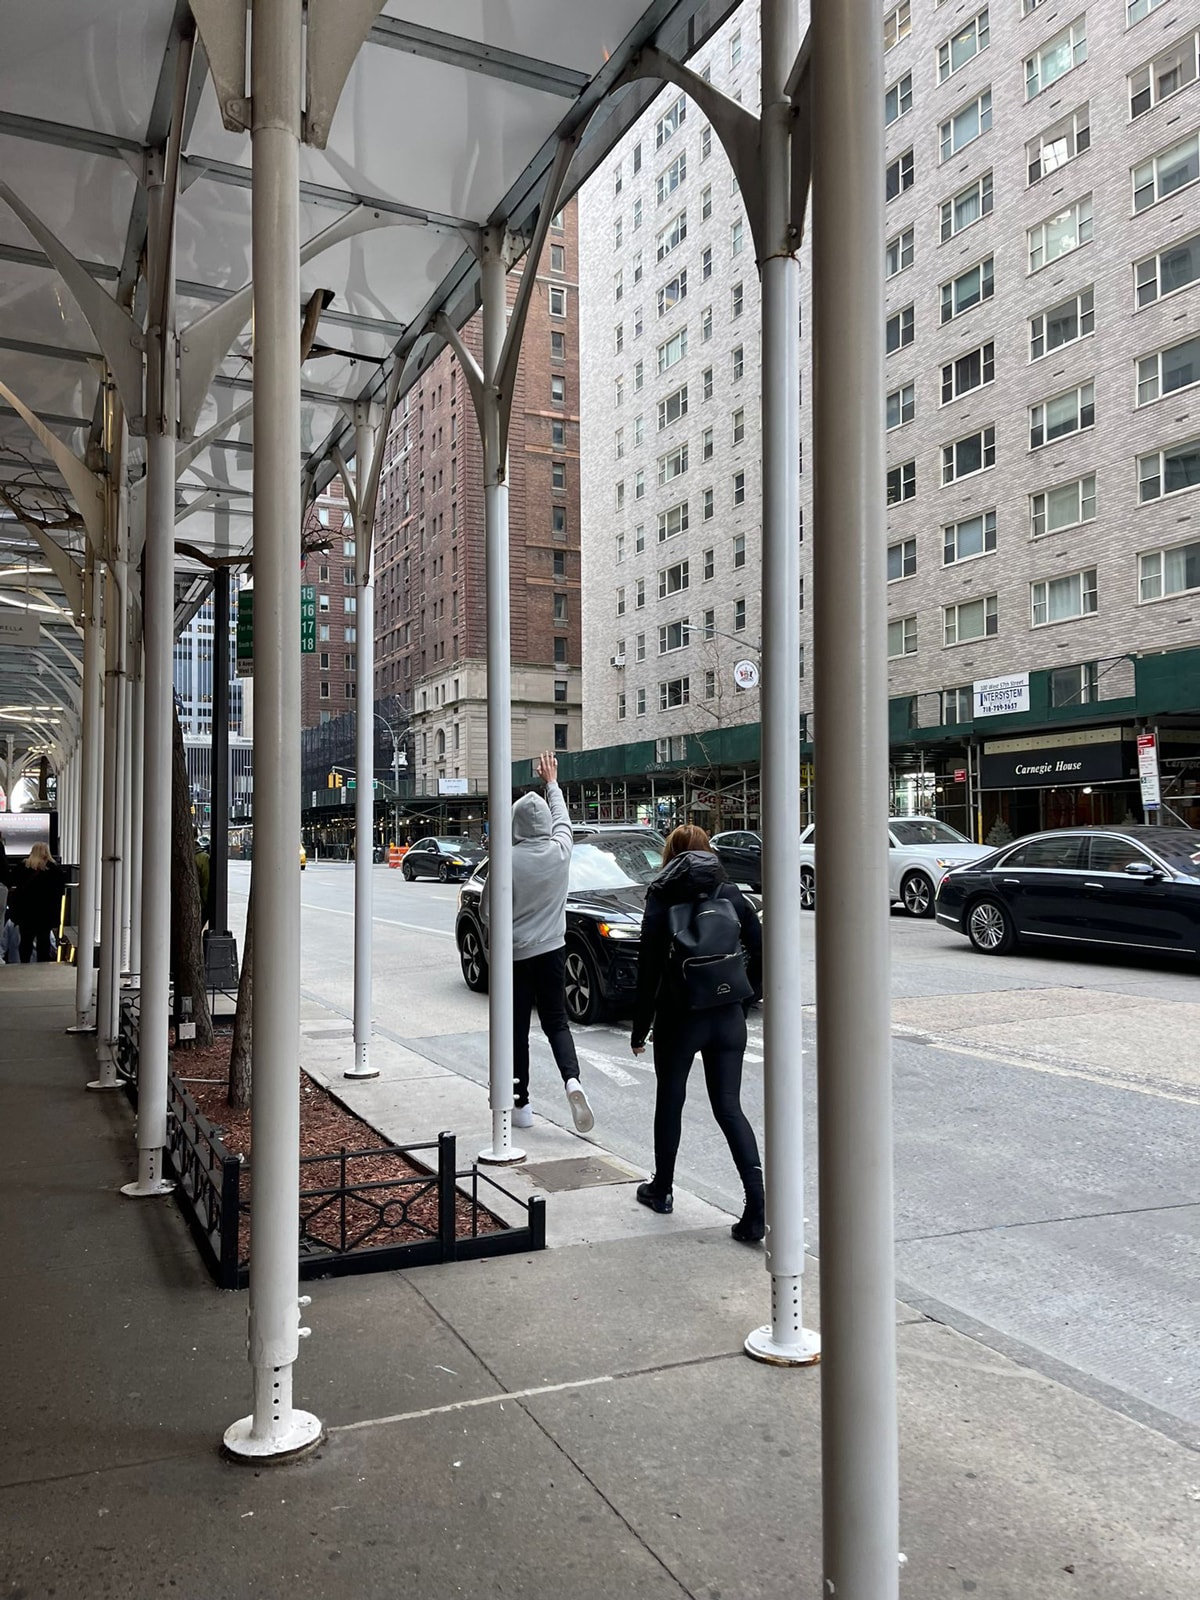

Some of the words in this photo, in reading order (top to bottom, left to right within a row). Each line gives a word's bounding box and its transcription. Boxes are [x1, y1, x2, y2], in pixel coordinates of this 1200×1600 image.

[301, 587, 313, 600] 15
[301, 604, 314, 616] 16
[301, 621, 314, 634] 17
[301, 638, 314, 650] 18
[980, 688, 1023, 706] INTERSYSTEM
[1015, 762, 1053, 775] Carnegie
[1055, 760, 1082, 772] House
